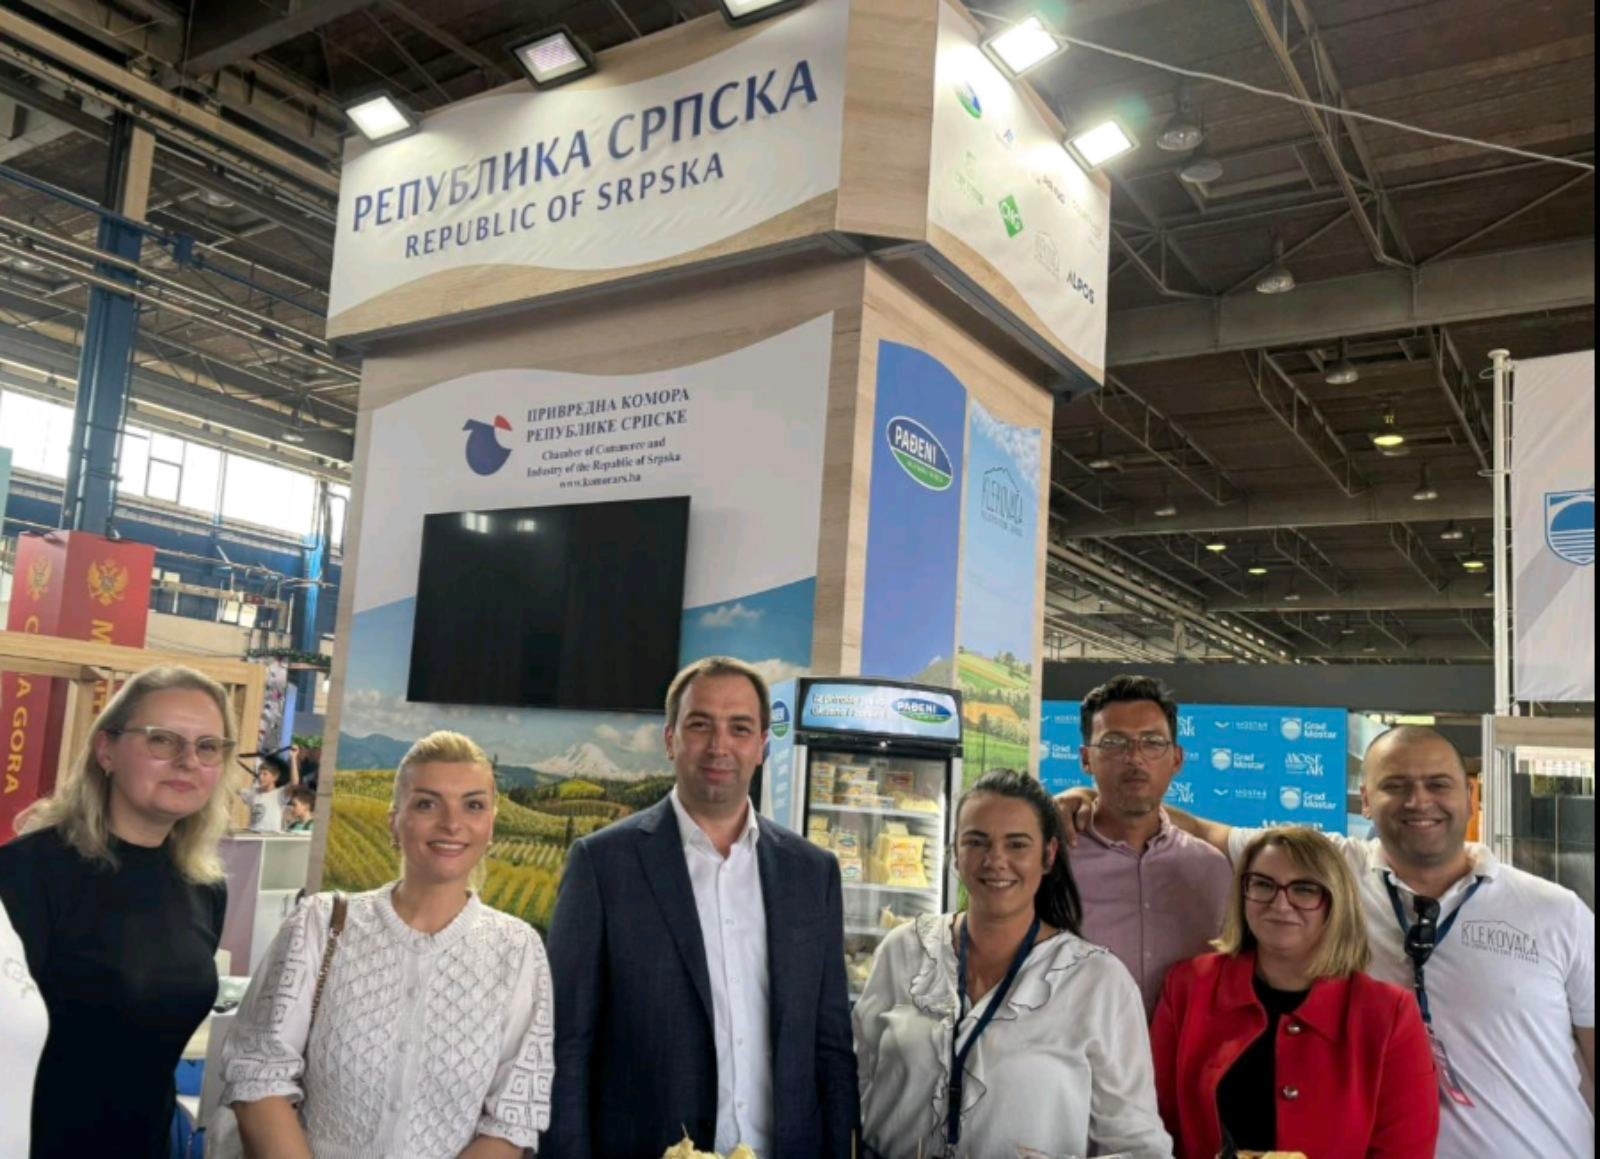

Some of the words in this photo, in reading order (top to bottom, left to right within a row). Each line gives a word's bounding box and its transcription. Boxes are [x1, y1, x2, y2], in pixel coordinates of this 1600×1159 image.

[352, 130, 592, 233] РЕПУБЛИКА
[607, 60, 820, 161] СРПСКА
[405, 202, 537, 259] REPUBLIC
[547, 189, 586, 224] OF
[596, 152, 725, 211] SRPSKA
[527, 399, 617, 423] ПРИВРЕДНА
[621, 387, 691, 410] КОМОРА
[526, 420, 617, 443] РЕПУБЛИКЕ
[621, 409, 688, 431] СРПСКЕ
[895, 425, 937, 465] PAĐENI
[527, 464, 562, 478] Industry
[565, 462, 574, 474] of
[576, 460, 591, 473] the
[593, 456, 633, 471] Republic
[636, 454, 645, 466] of
[647, 452, 681, 467] Srpska
[542, 448, 582, 461] Chamber
[585, 445, 594, 457] of
[595, 441, 645, 455] Commerce
[648, 437, 666, 450] and
[4, 706, 28, 793] GORA
